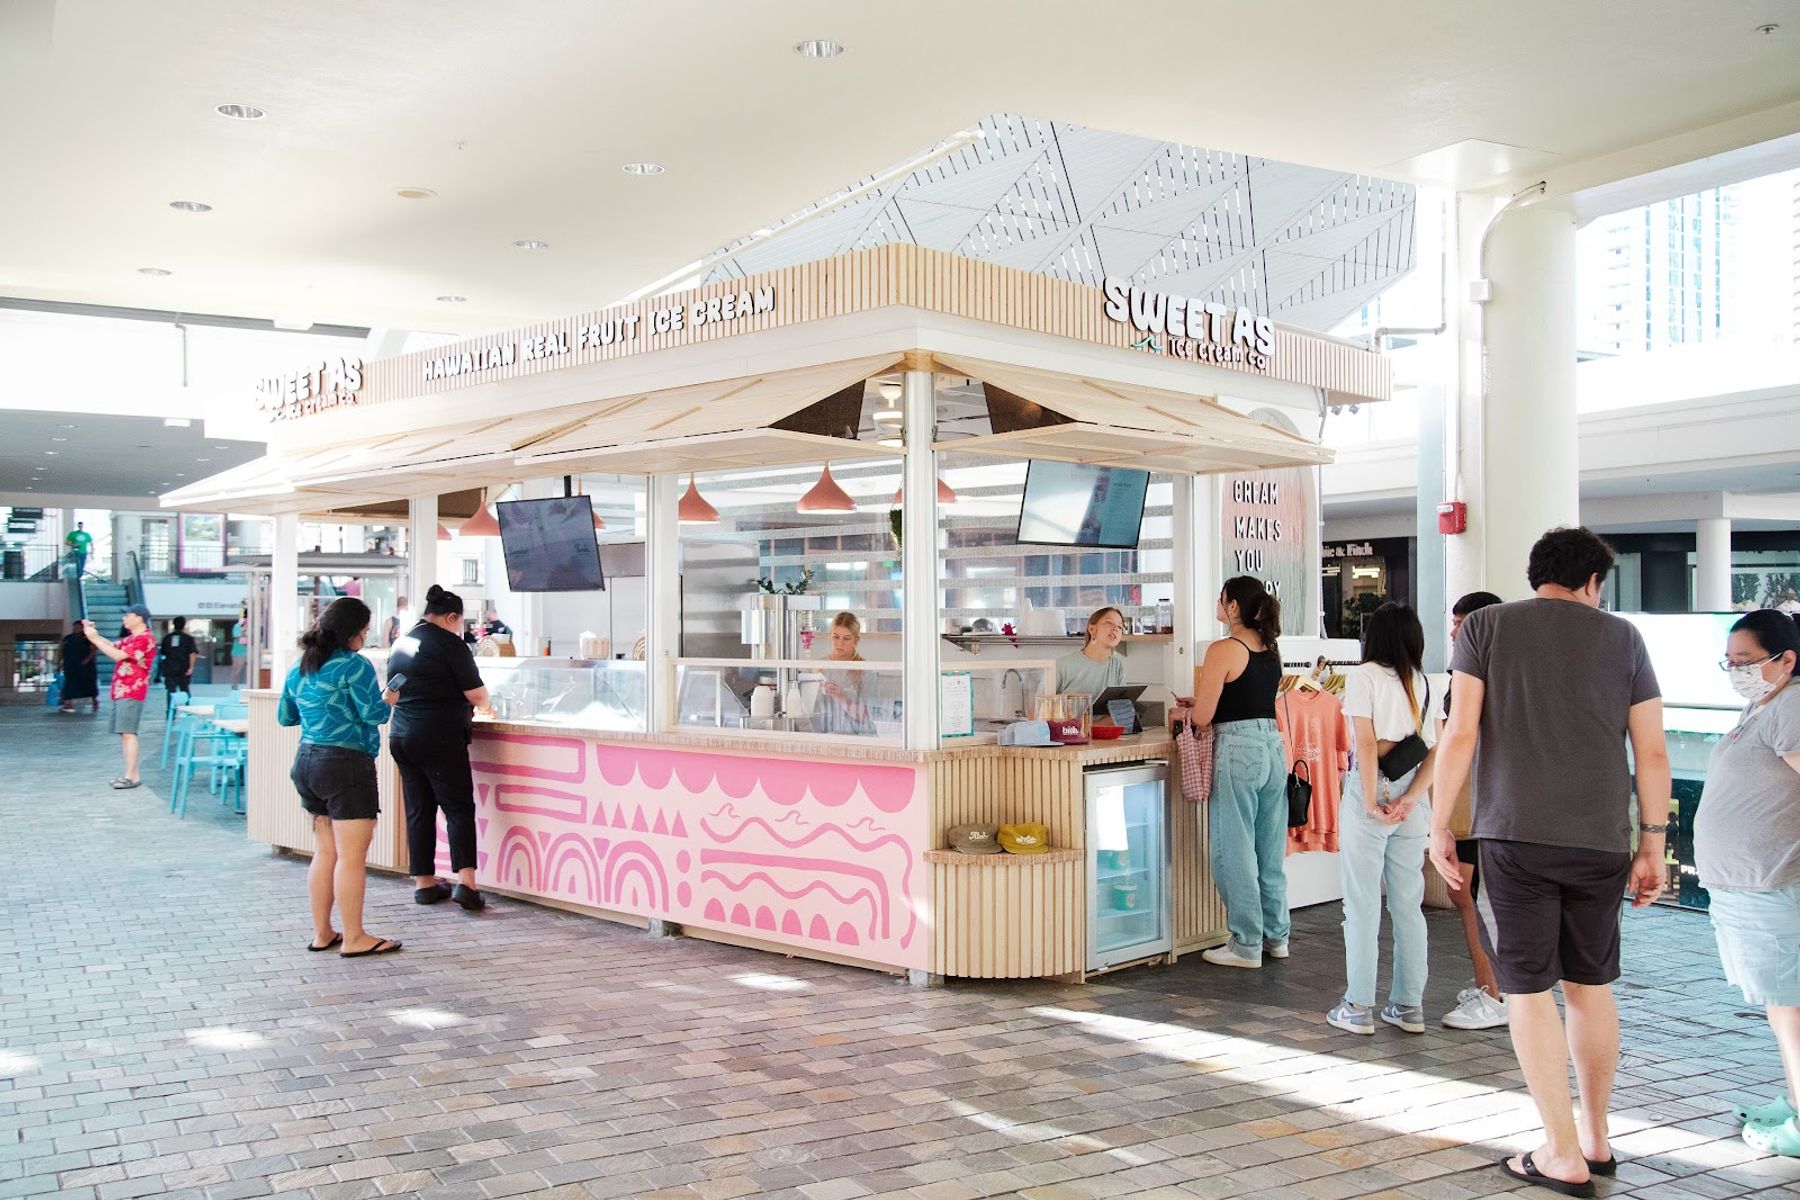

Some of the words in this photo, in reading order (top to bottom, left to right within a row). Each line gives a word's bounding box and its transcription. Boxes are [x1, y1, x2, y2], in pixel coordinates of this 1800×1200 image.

[1103, 275, 1227, 343] SWEET
[1233, 306, 1275, 356] AS
[424, 343, 516, 381] HAWAIIAN
[521, 331, 570, 361] REAL
[577, 315, 640, 350] FRUIT
[650, 304, 685, 336] ICE
[691, 285, 776, 326] CREAM
[1198, 342, 1244, 363] cream
[254, 361, 327, 411] SWEET
[328, 355, 363, 393] AS
[1233, 480, 1279, 505] CREAM
[1234, 516, 1282, 542] MAKES
[1234, 549, 1263, 572] YOU
